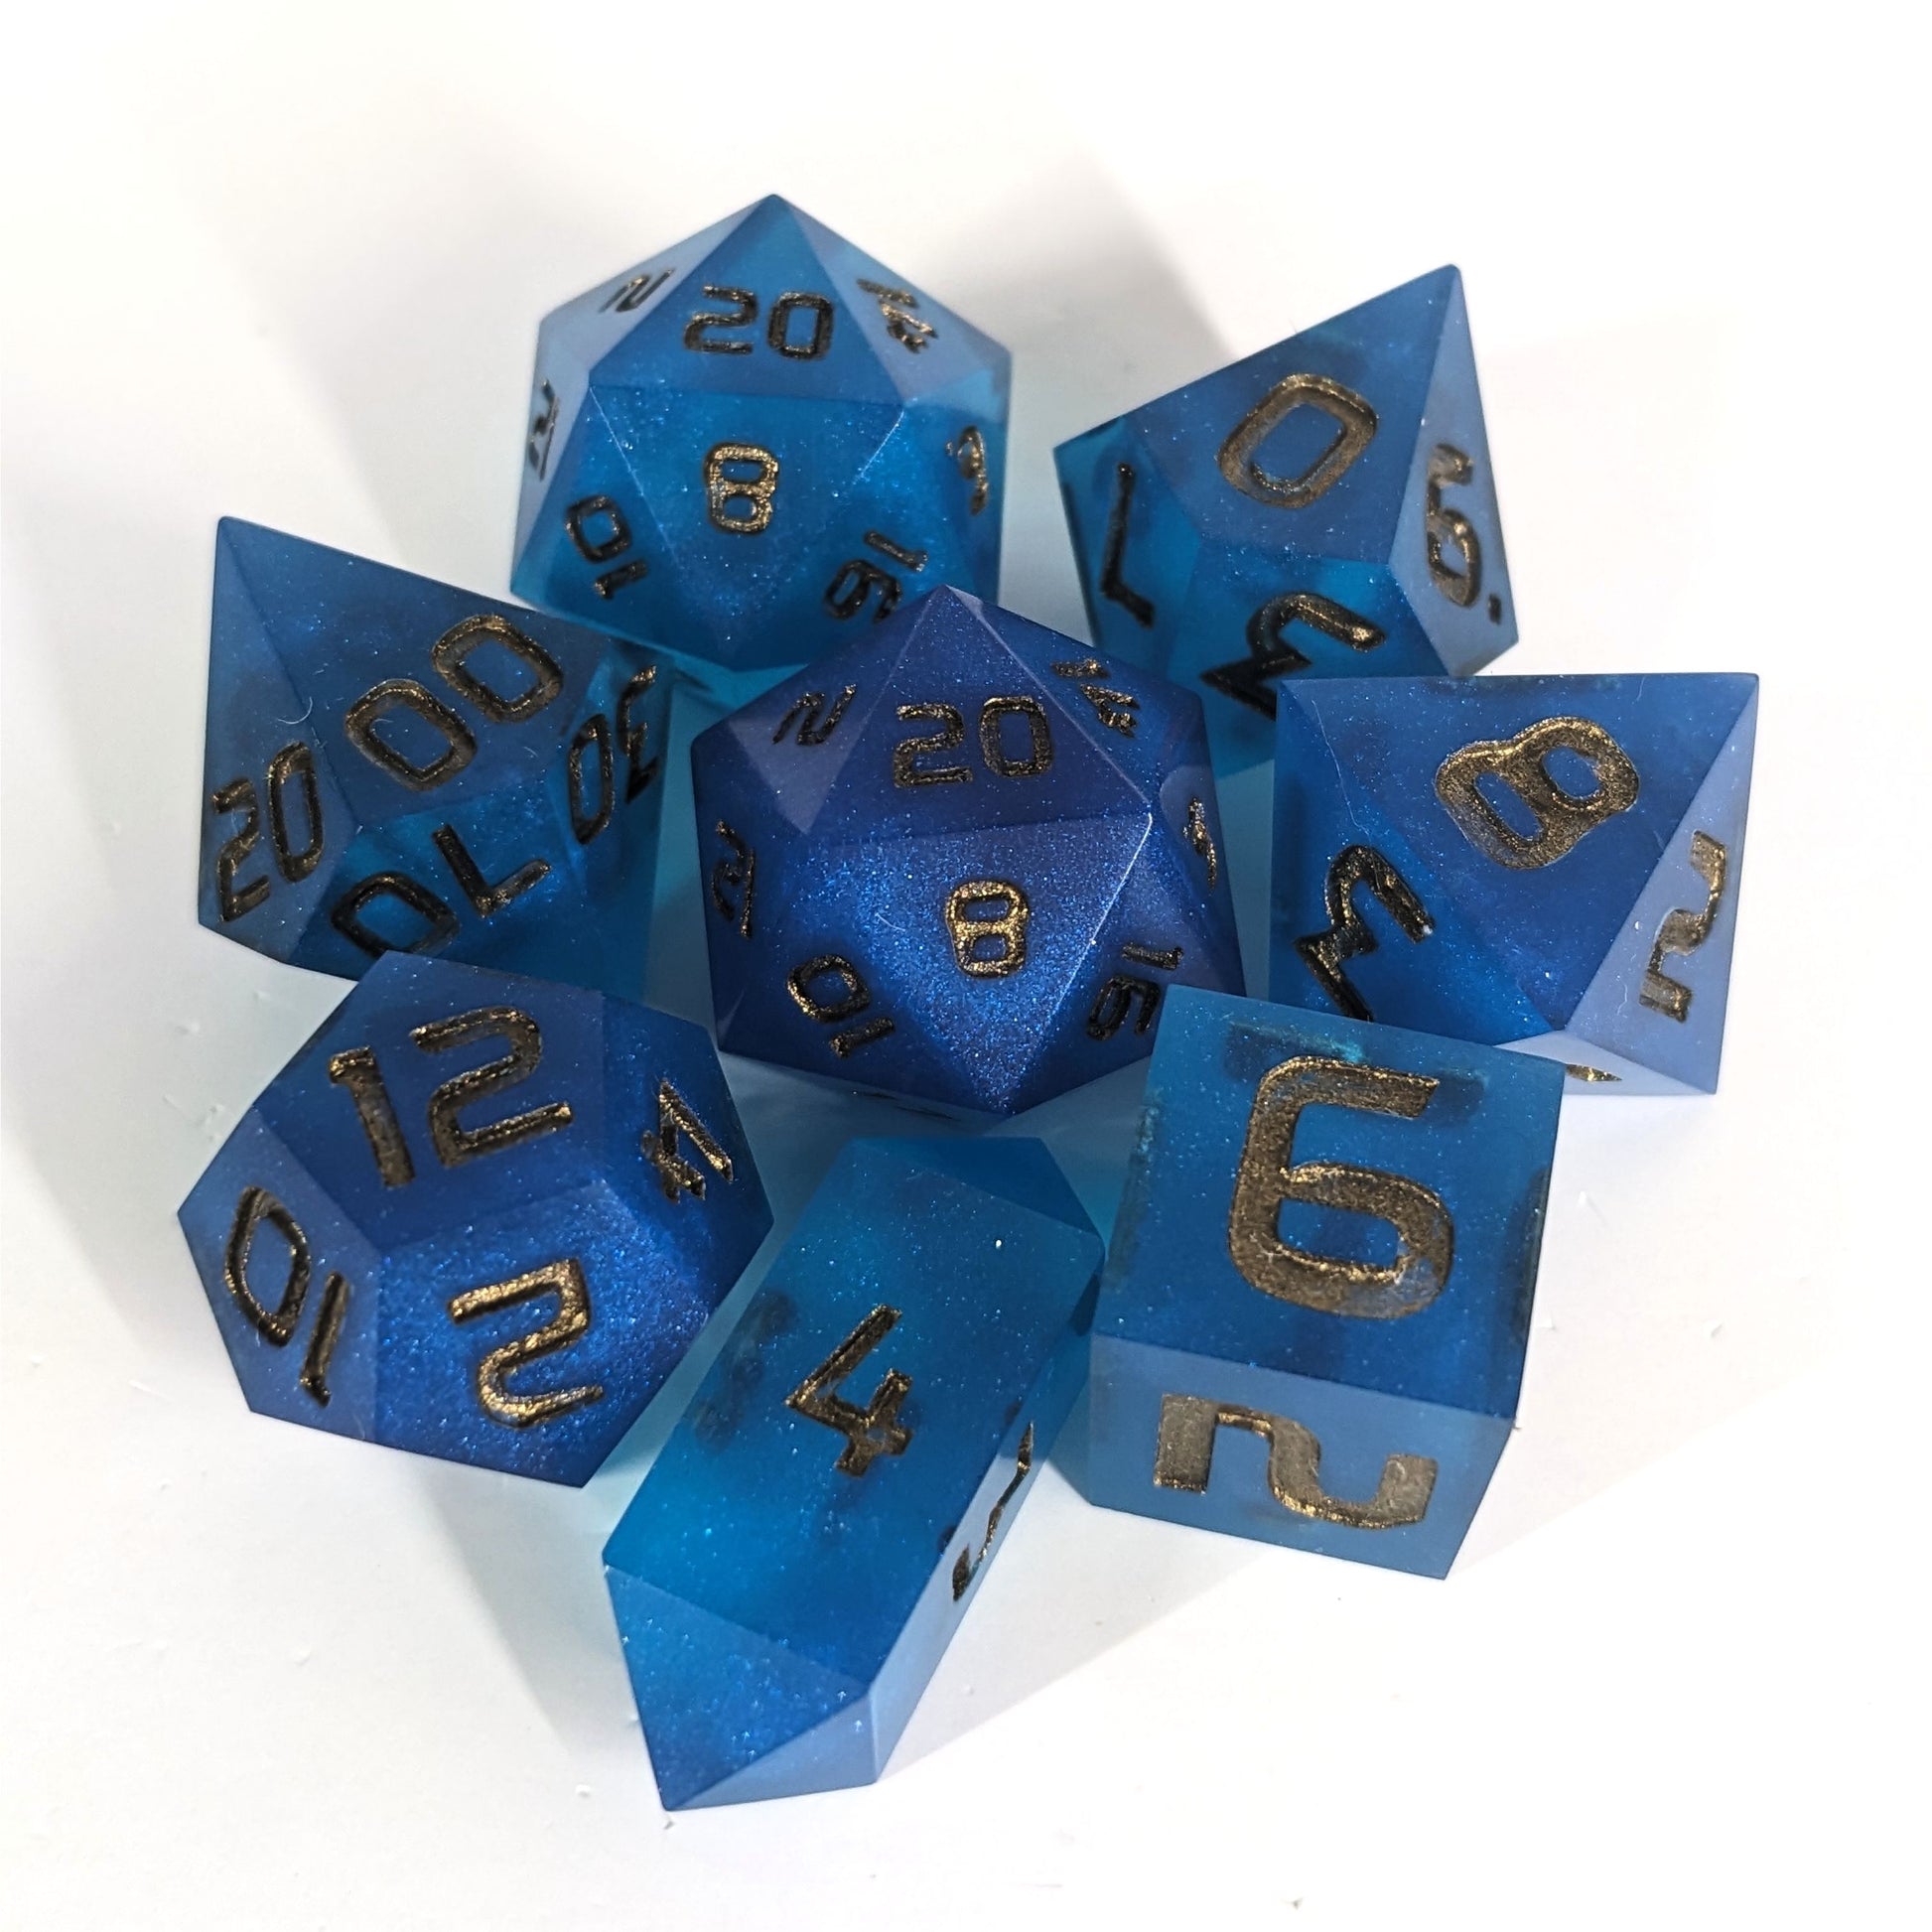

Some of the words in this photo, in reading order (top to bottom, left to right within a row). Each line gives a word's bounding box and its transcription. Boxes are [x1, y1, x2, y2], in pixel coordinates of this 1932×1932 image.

[683, 282, 834, 359] 20
[703, 442, 780, 535] 8
[1216, 373, 1378, 509] 0
[565, 495, 648, 601] 10
[823, 529, 929, 624] 16
[345, 614, 564, 791] 00
[893, 695, 1054, 788] 20
[211, 742, 324, 922] 20
[1435, 715, 1641, 871] 8
[944, 880, 1031, 980] 8
[1087, 941, 1183, 1041] 16
[786, 952, 895, 1058] 10
[329, 1005, 575, 1188] 12
[641, 1078, 735, 1204] 4
[1227, 1054, 1456, 1319] 6
[223, 1185, 351, 1408] 10
[447, 1258, 605, 1430] 2
[785, 1302, 914, 1480] 4
[1153, 1393, 1440, 1531] 2
